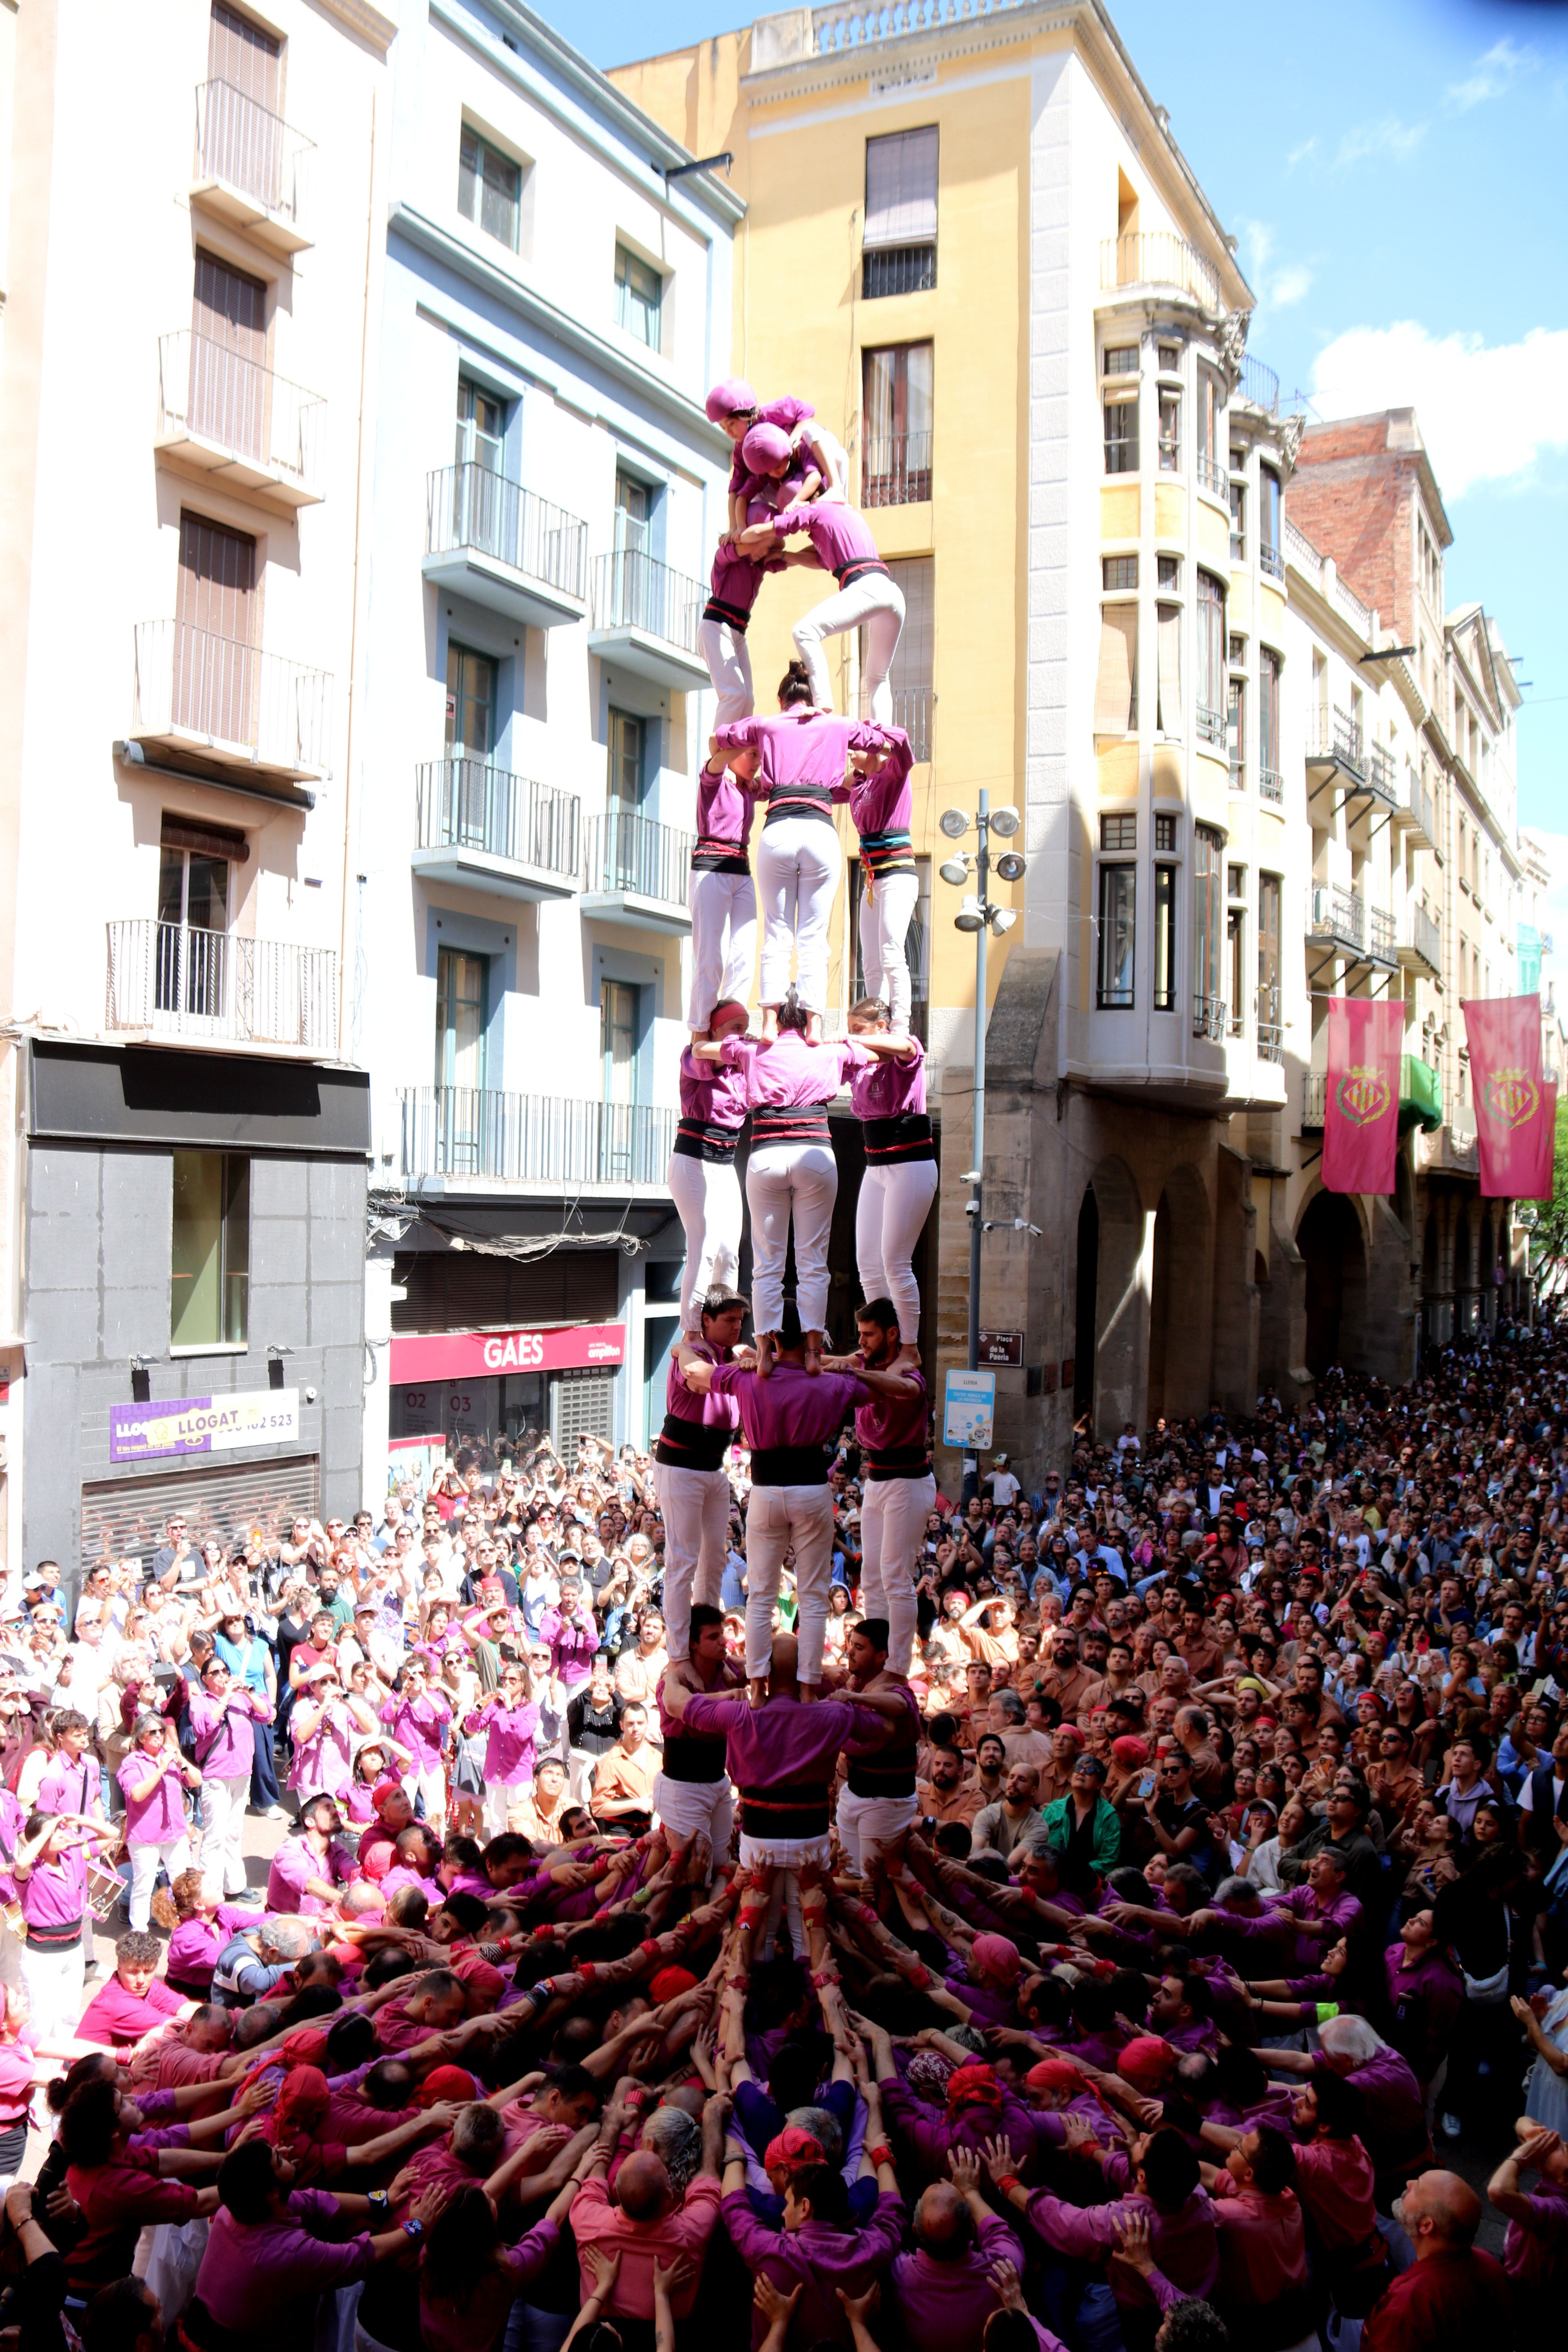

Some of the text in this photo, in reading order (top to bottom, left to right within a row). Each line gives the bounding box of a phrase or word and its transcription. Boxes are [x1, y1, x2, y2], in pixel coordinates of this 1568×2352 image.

[484, 1333, 543, 1368] GAES
[588, 1345, 620, 1360] amplifon
[990, 1353, 1009, 1361] Paeria
[406, 1393, 426, 1408] 02
[450, 1396, 471, 1412] 03
[179, 1410, 238, 1435] LLOGAT
[271, 1414, 292, 1427] 523
